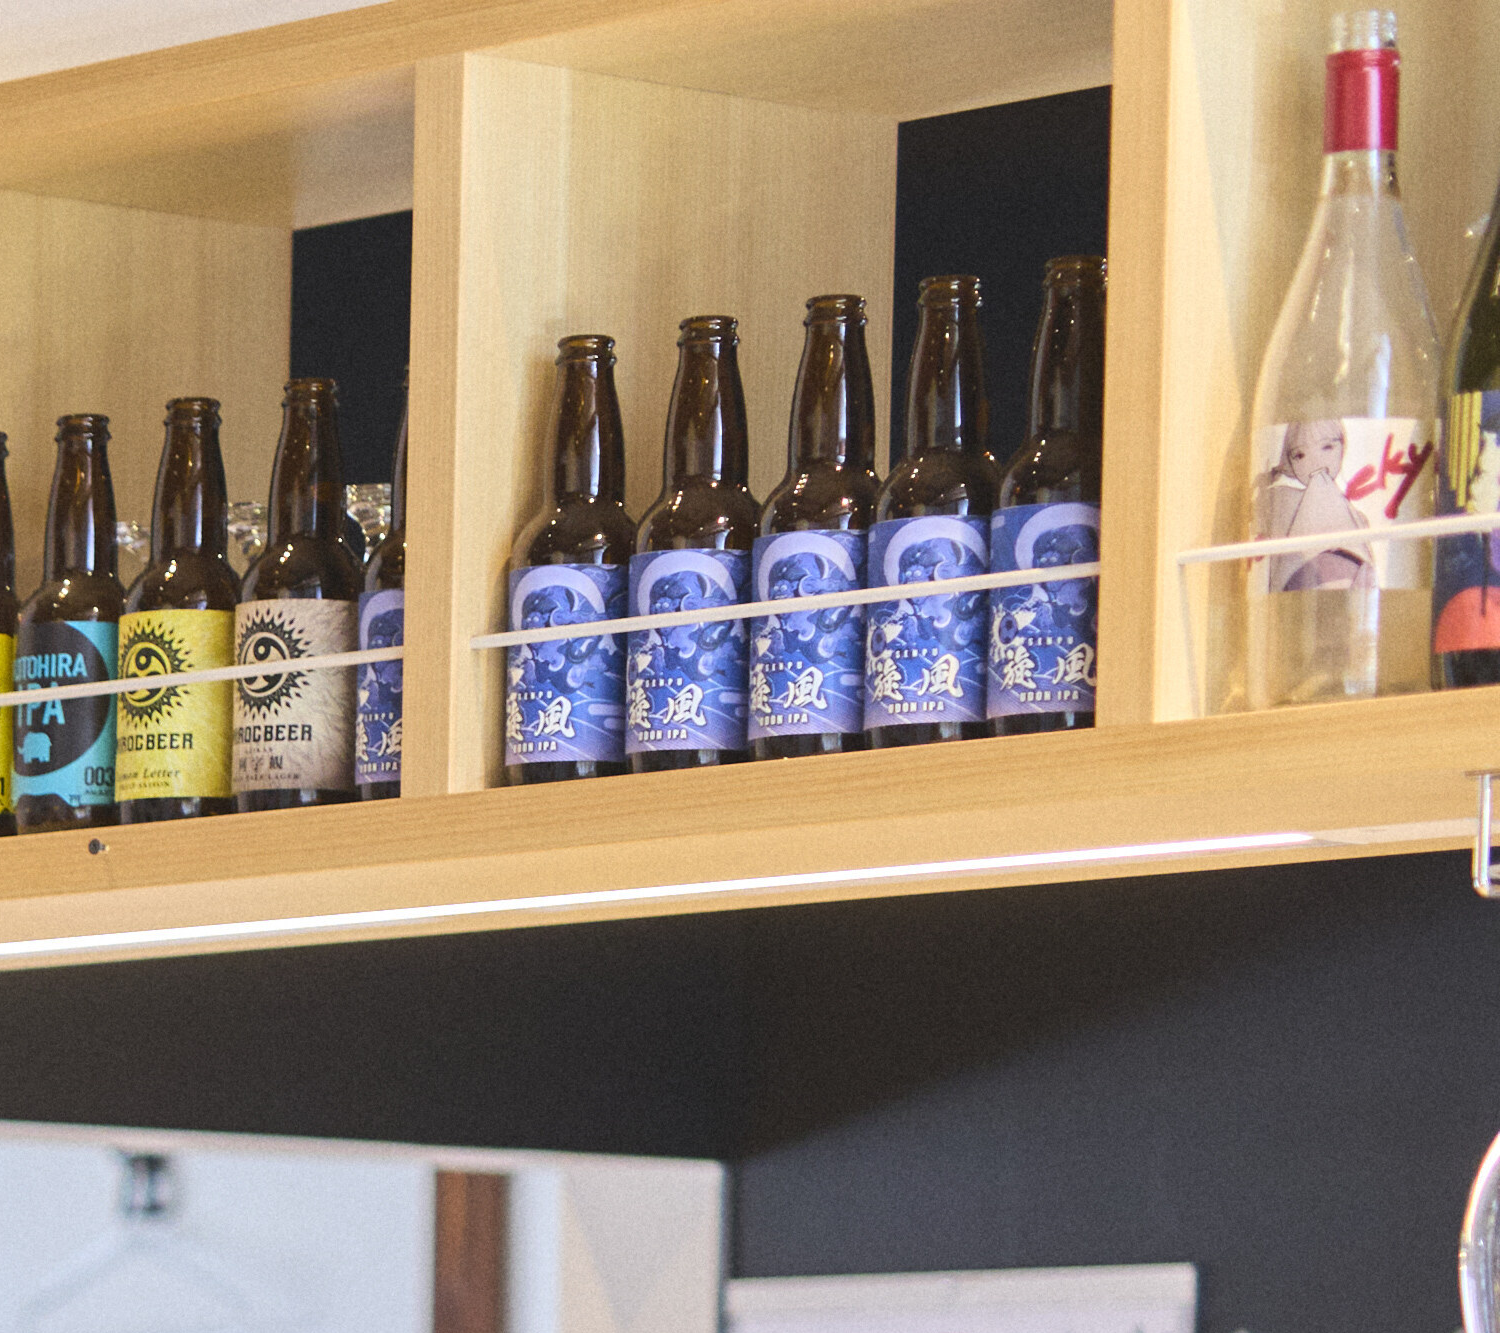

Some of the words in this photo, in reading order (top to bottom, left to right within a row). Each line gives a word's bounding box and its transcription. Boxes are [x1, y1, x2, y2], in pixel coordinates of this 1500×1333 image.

[1057, 690, 1080, 701] IPA
[17, 682, 66, 727] IPA
[922, 701, 946, 712] IPA
[788, 713, 809, 724] IPA
[667, 729, 688, 740] IPA
[538, 741, 558, 752] IPA
